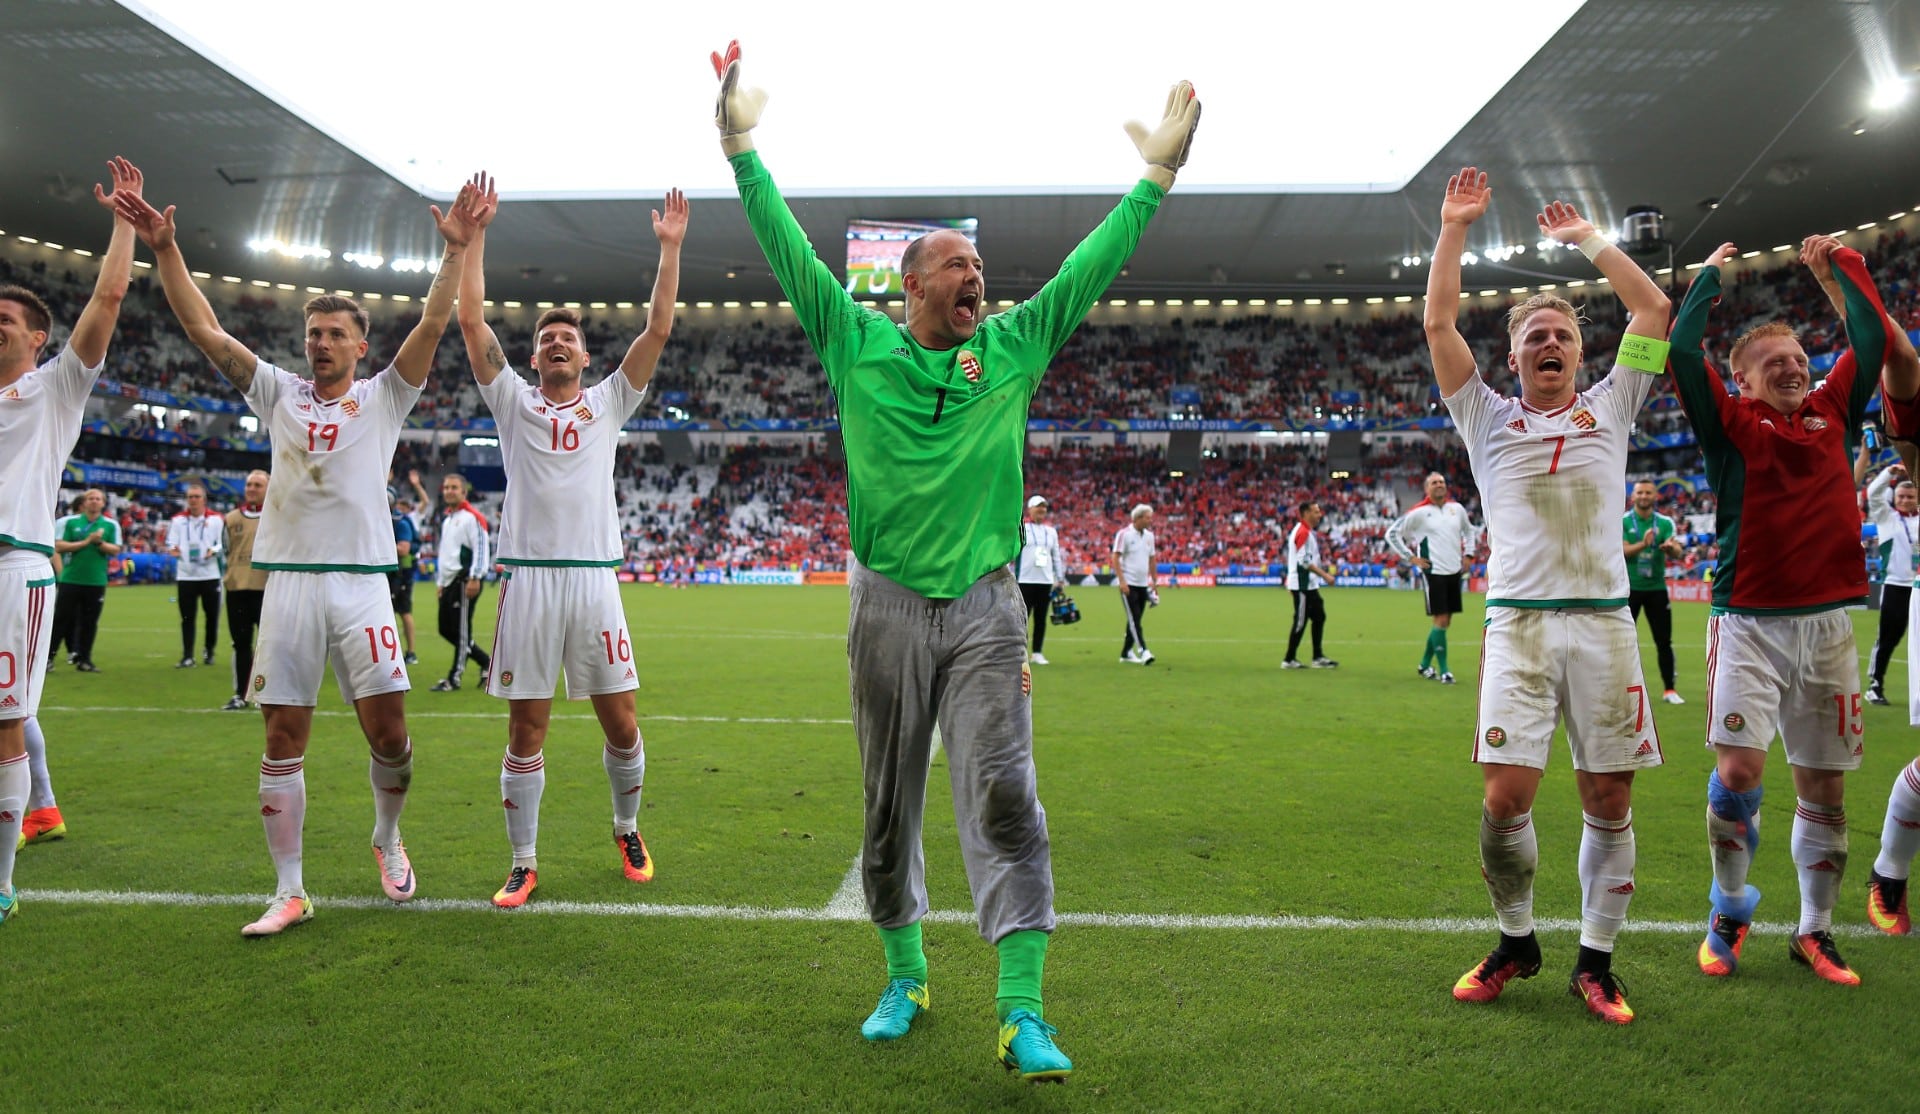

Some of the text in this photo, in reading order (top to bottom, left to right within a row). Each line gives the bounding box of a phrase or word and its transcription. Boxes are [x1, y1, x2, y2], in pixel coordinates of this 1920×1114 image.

[932, 388, 947, 424] 1
[308, 422, 338, 452] 19
[551, 418, 579, 451] 16
[1137, 420, 1229, 430] UEFA EURO 2016
[1542, 435, 1565, 475] 7
[365, 625, 397, 664] 19
[602, 628, 630, 665] 16
[1626, 685, 1644, 733] 7
[1833, 692, 1863, 737] 15
